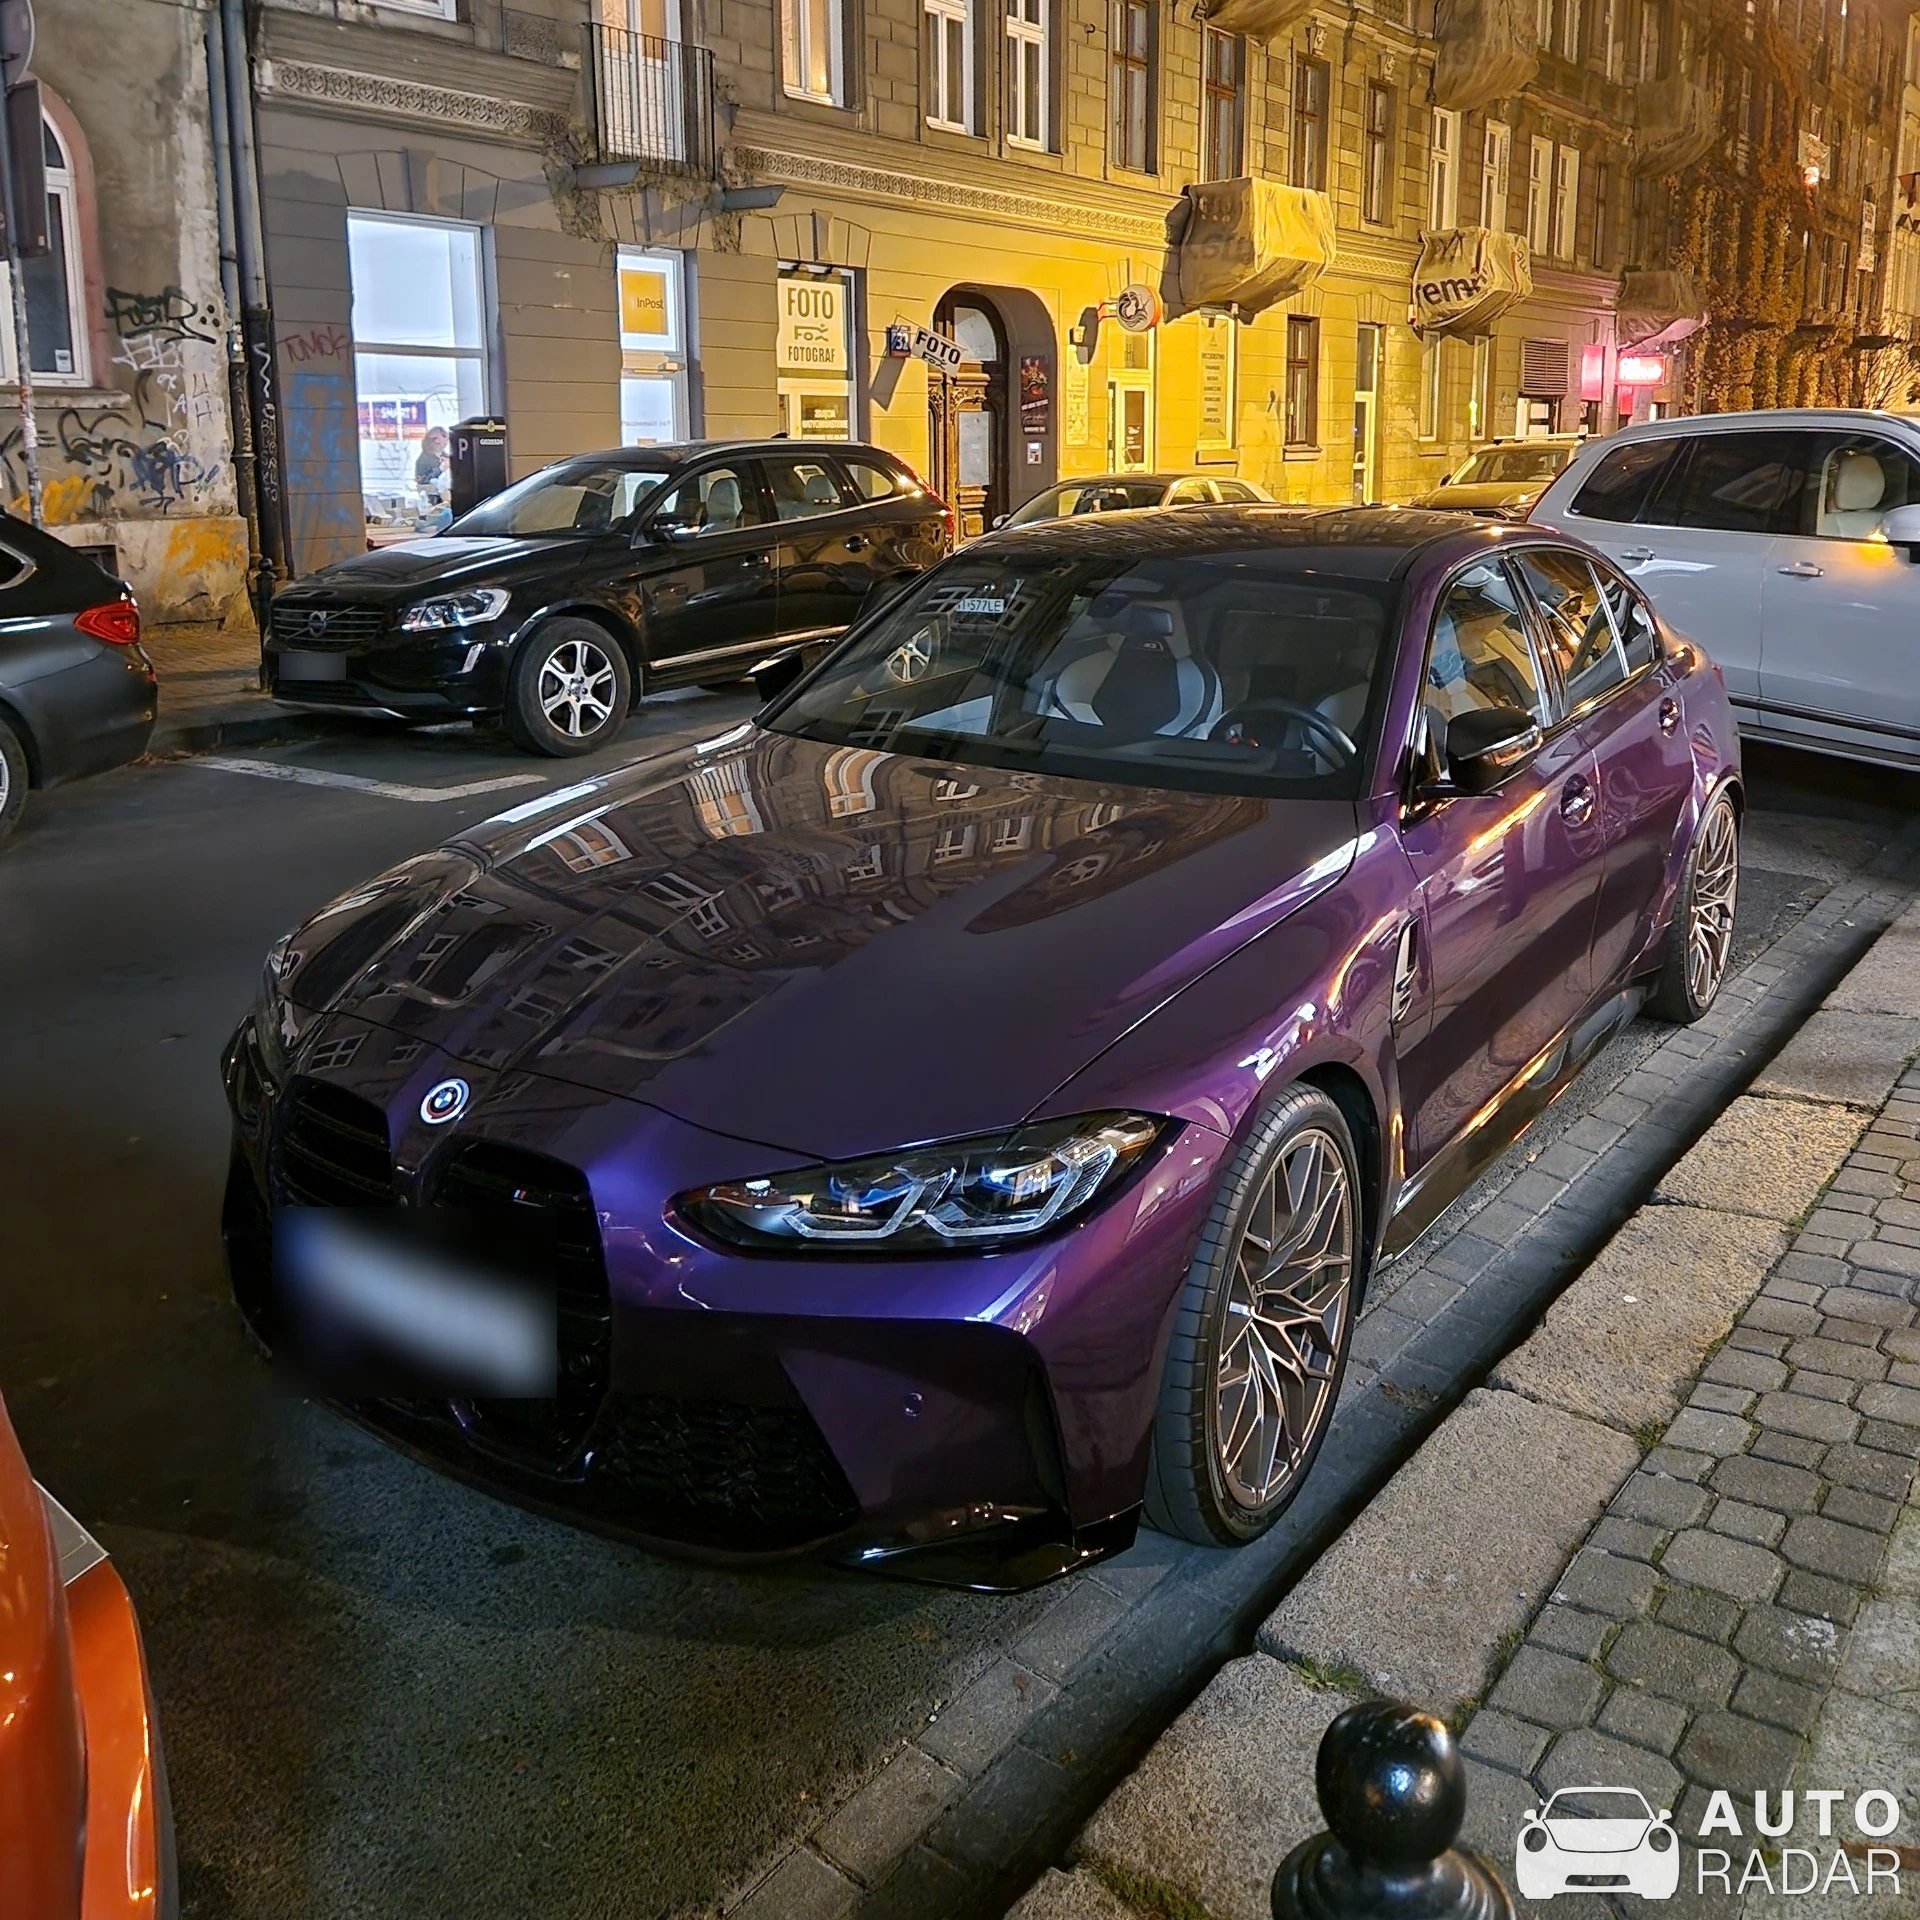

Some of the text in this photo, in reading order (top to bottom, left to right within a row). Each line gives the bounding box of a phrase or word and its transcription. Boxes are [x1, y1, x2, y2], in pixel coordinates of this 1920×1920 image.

[637, 297, 664, 310] InPost
[787, 287, 834, 319] FOTO
[788, 345, 835, 363] FOTOGRAF
[916, 331, 961, 365] FOTO
[458, 438, 468, 460] P
